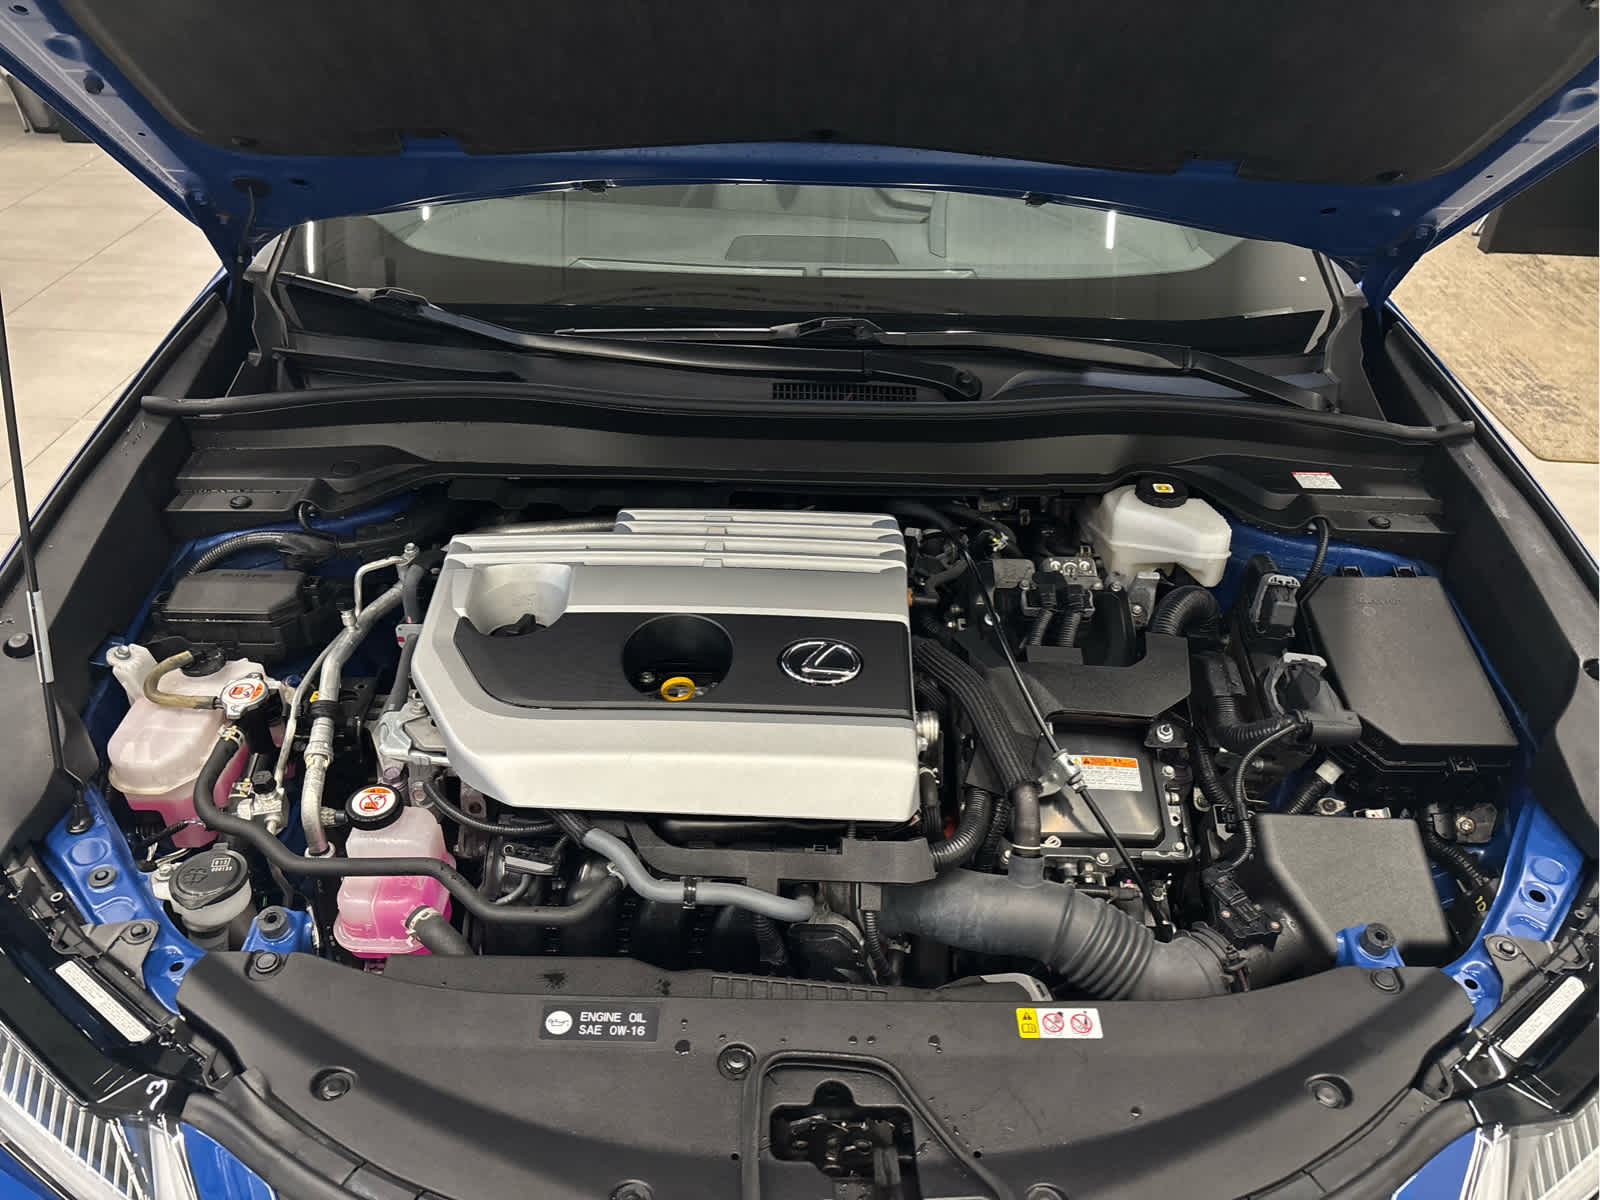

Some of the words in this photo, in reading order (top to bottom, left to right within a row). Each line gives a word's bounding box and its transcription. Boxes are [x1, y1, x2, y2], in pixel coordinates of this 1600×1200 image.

[580, 1011, 622, 1023] ENGINE
[628, 1012, 647, 1023] OIL
[578, 1024, 603, 1036] SAE
